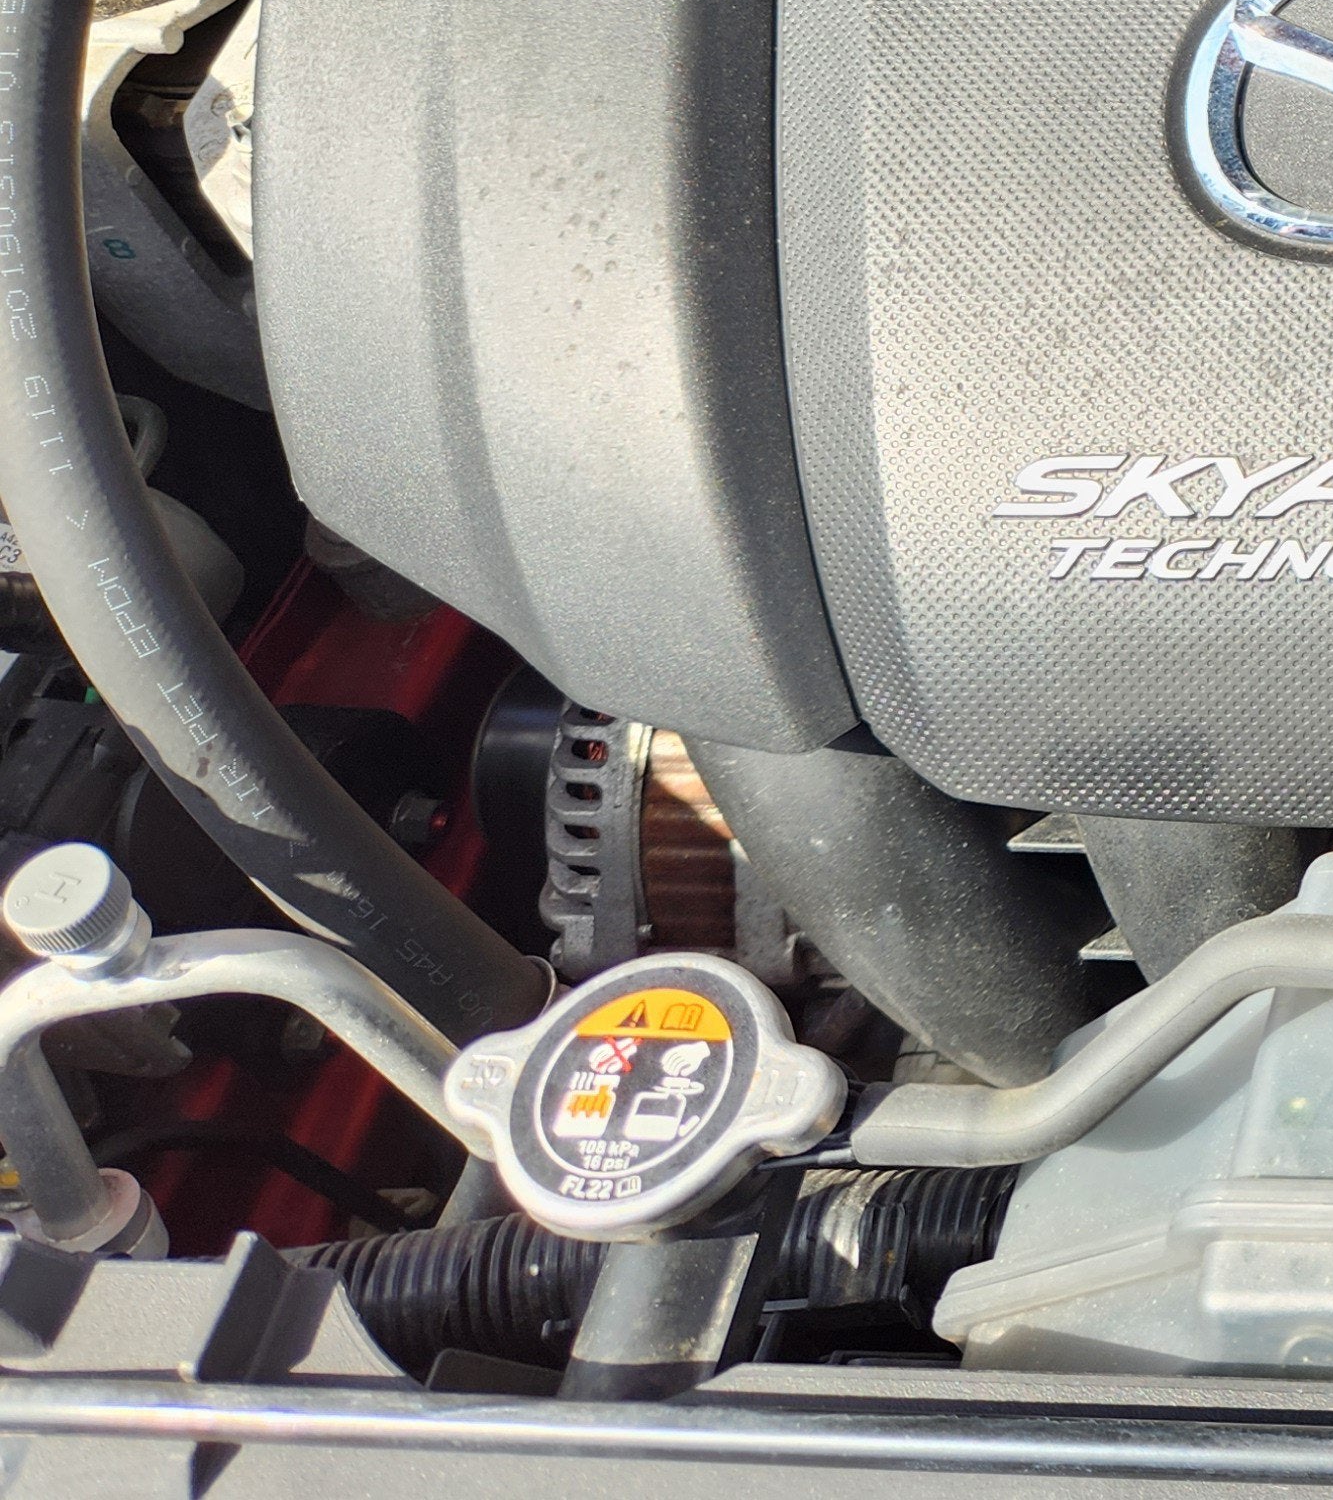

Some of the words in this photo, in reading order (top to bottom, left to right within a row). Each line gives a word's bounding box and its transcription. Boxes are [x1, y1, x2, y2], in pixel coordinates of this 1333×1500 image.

[24, 374, 74, 476] 1119
[87, 556, 161, 659] EPDM
[156, 682, 219, 747] PET
[578, 1139, 607, 1156] 108
[607, 1140, 640, 1158] kPa
[583, 1154, 602, 1171] 16
[601, 1155, 631, 1173] psi
[560, 1173, 614, 1200] FL22
